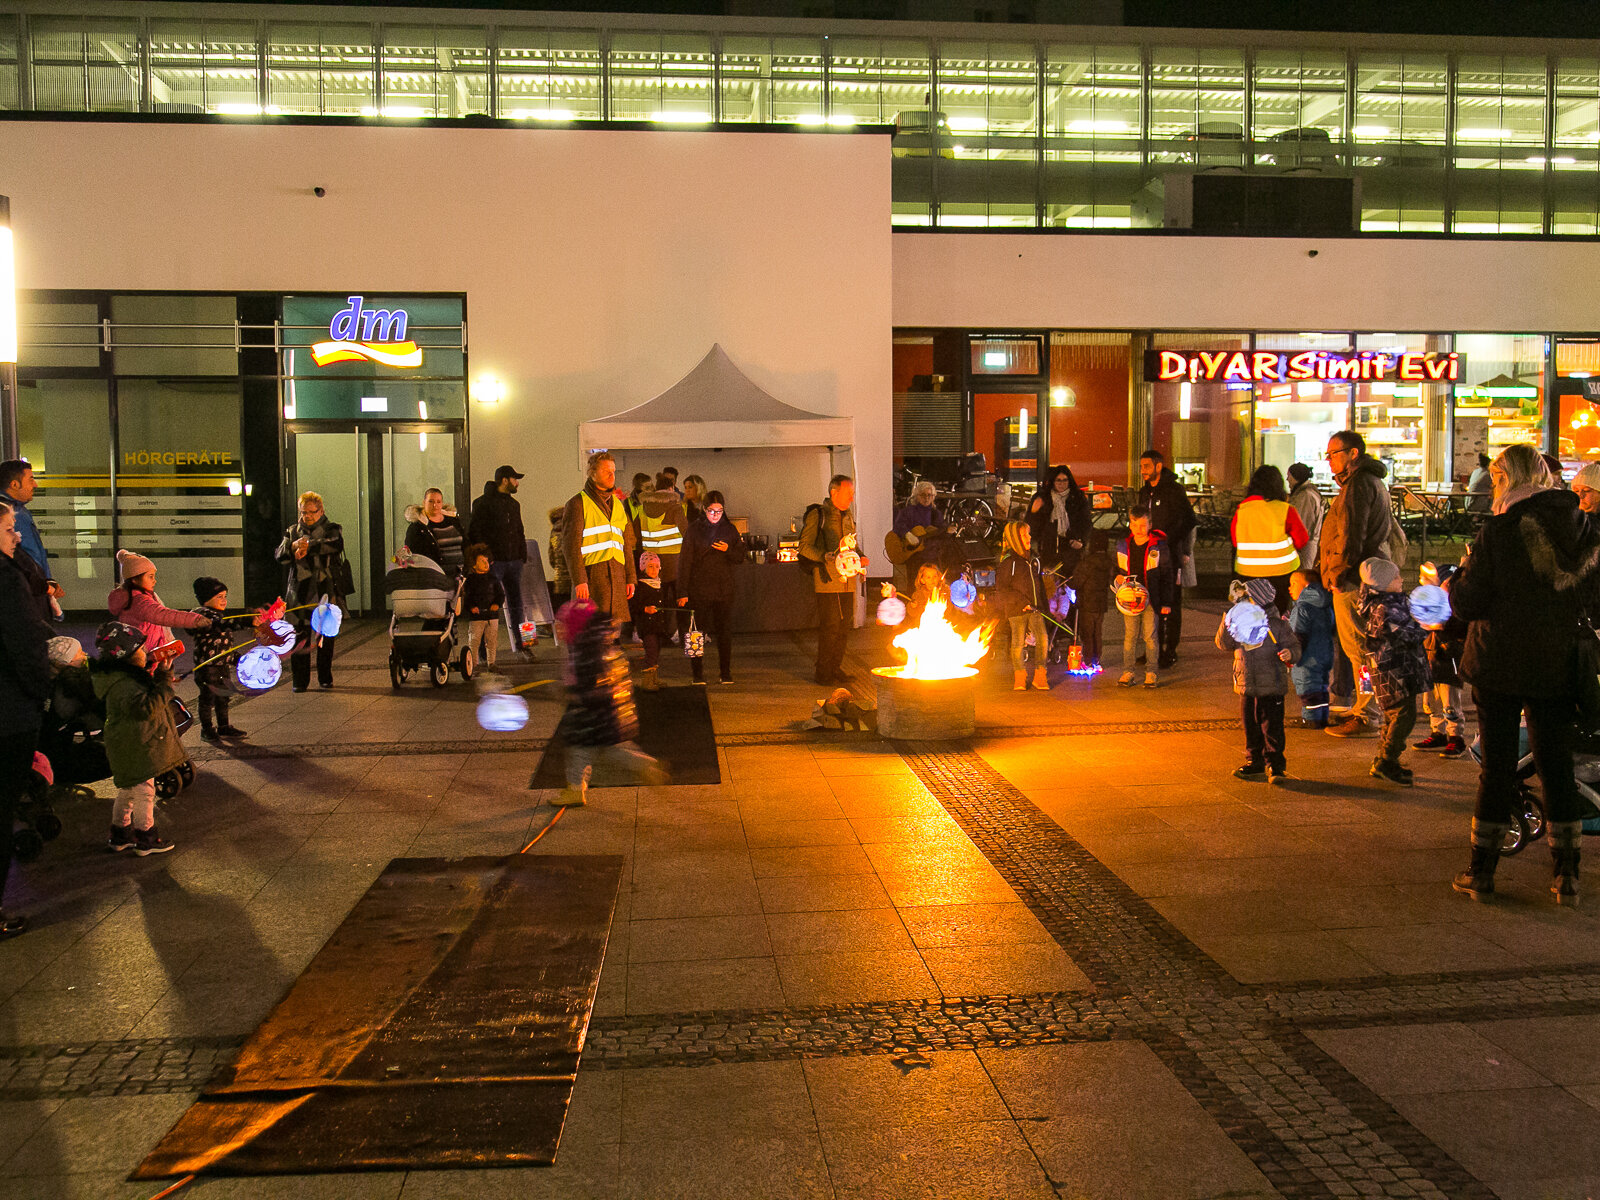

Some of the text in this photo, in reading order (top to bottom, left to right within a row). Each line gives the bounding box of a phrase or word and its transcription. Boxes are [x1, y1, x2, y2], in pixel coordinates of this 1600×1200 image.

[330, 296, 408, 341] dm
[1287, 350, 1388, 380] Simit
[1400, 351, 1459, 380] Evi
[124, 449, 233, 465] HÖRGERÄTE
